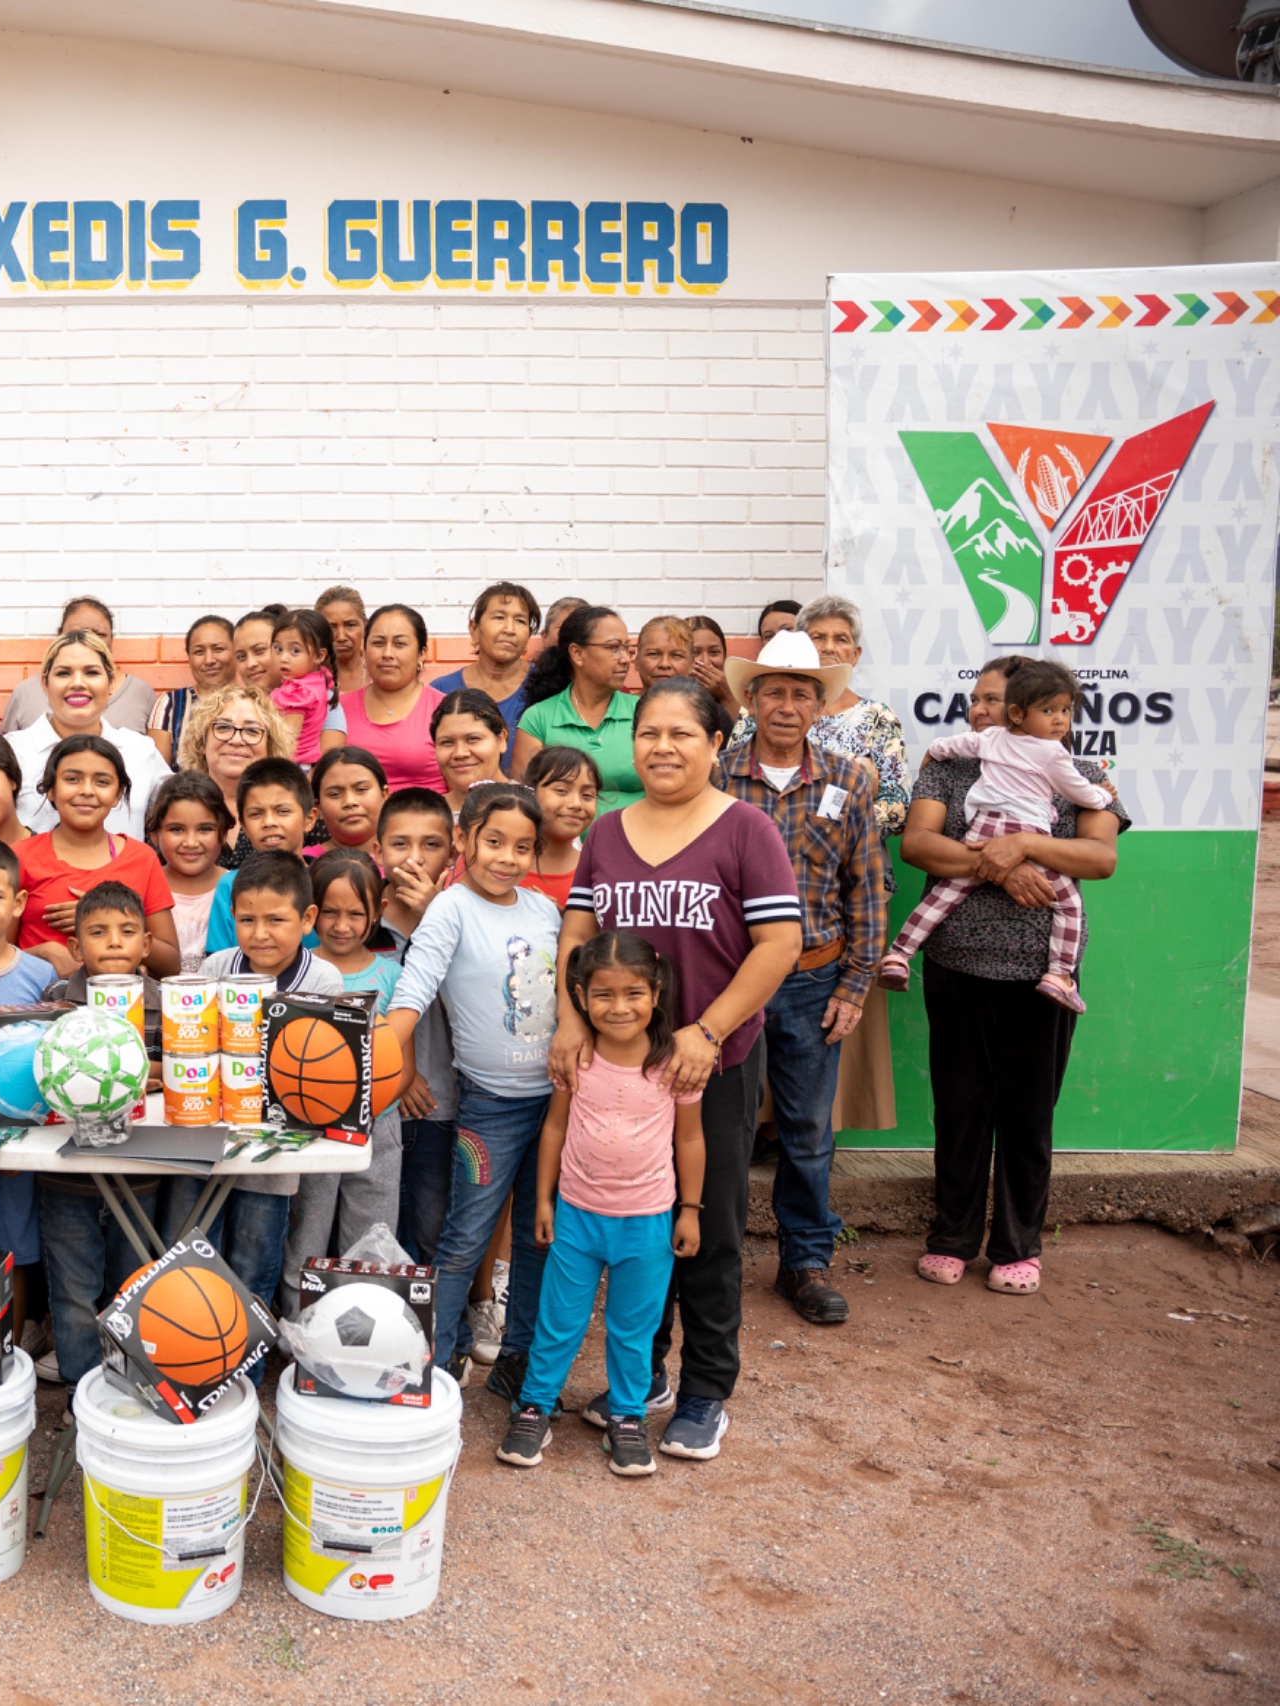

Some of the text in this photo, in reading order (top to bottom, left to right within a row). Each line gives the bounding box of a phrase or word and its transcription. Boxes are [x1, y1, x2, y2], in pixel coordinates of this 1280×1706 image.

[234, 200, 307, 296] G.
[323, 200, 730, 296] GUERRERO
[1071, 669, 1129, 680] SCIPLINA
[913, 683, 1173, 725] CAÑOS
[1070, 730, 1117, 756] NZA
[593, 880, 721, 931] PINK
[94, 990, 131, 1007] Doal
[169, 990, 207, 1006] Doal
[226, 989, 262, 1005] Doal
[177, 1027, 200, 1039] 900
[232, 1026, 255, 1038] 900
[173, 1062, 210, 1079] Doal
[182, 1099, 204, 1111] 900
[240, 1099, 262, 1110] 900
[345, 1133, 352, 1141] 7
[301, 1281, 327, 1293] Voit
